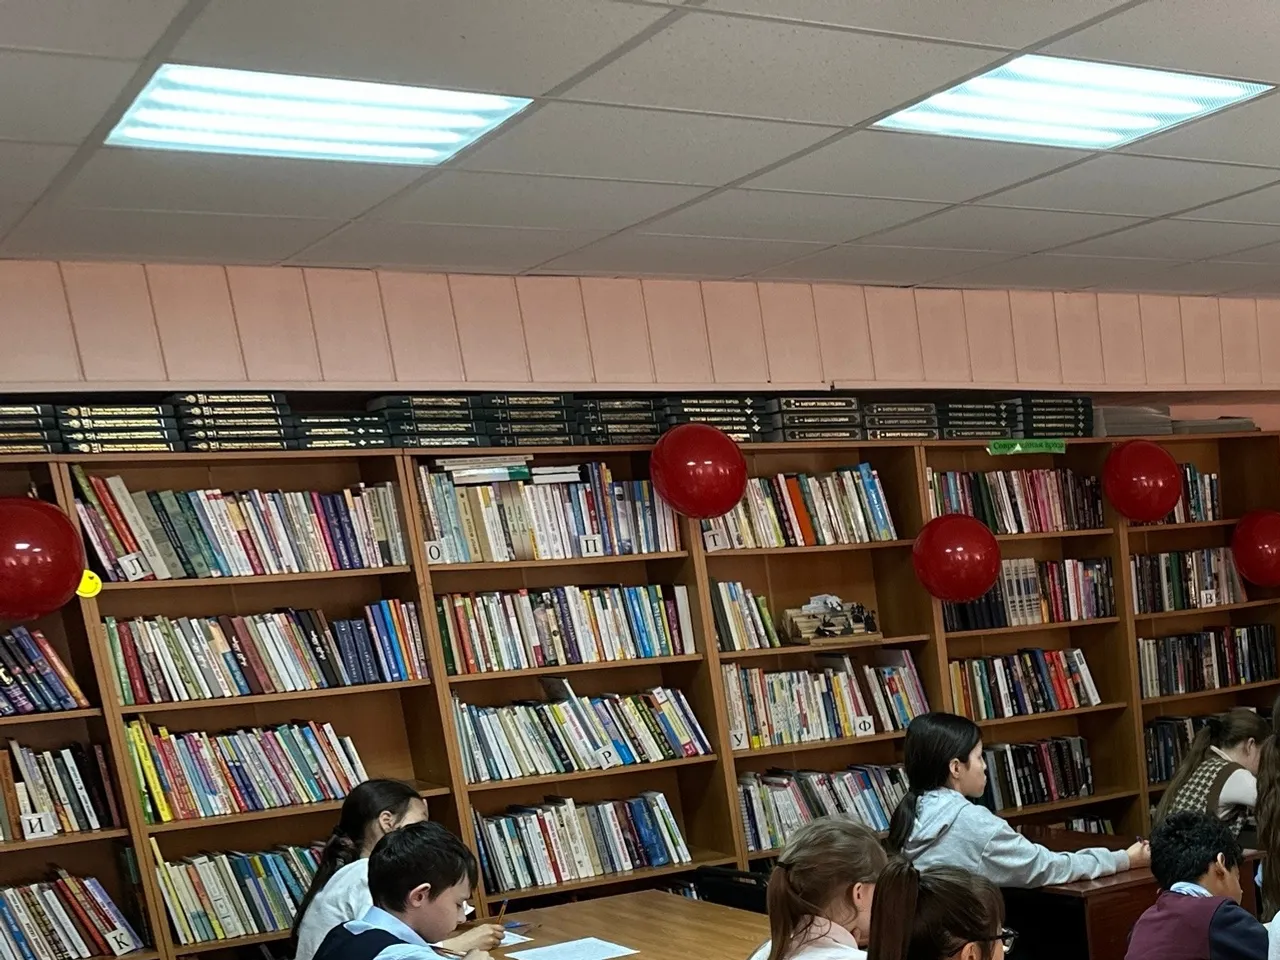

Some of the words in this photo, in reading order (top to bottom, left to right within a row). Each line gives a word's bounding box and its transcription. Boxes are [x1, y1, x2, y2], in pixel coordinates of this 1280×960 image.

[584, 539, 598, 553] П
[708, 533, 719, 547] Т
[127, 558, 146, 577] Л
[859, 720, 872, 732] Ф
[733, 732, 744, 746] У
[603, 750, 612, 764] Р
[28, 818, 46, 835] И
[113, 933, 131, 950] К
